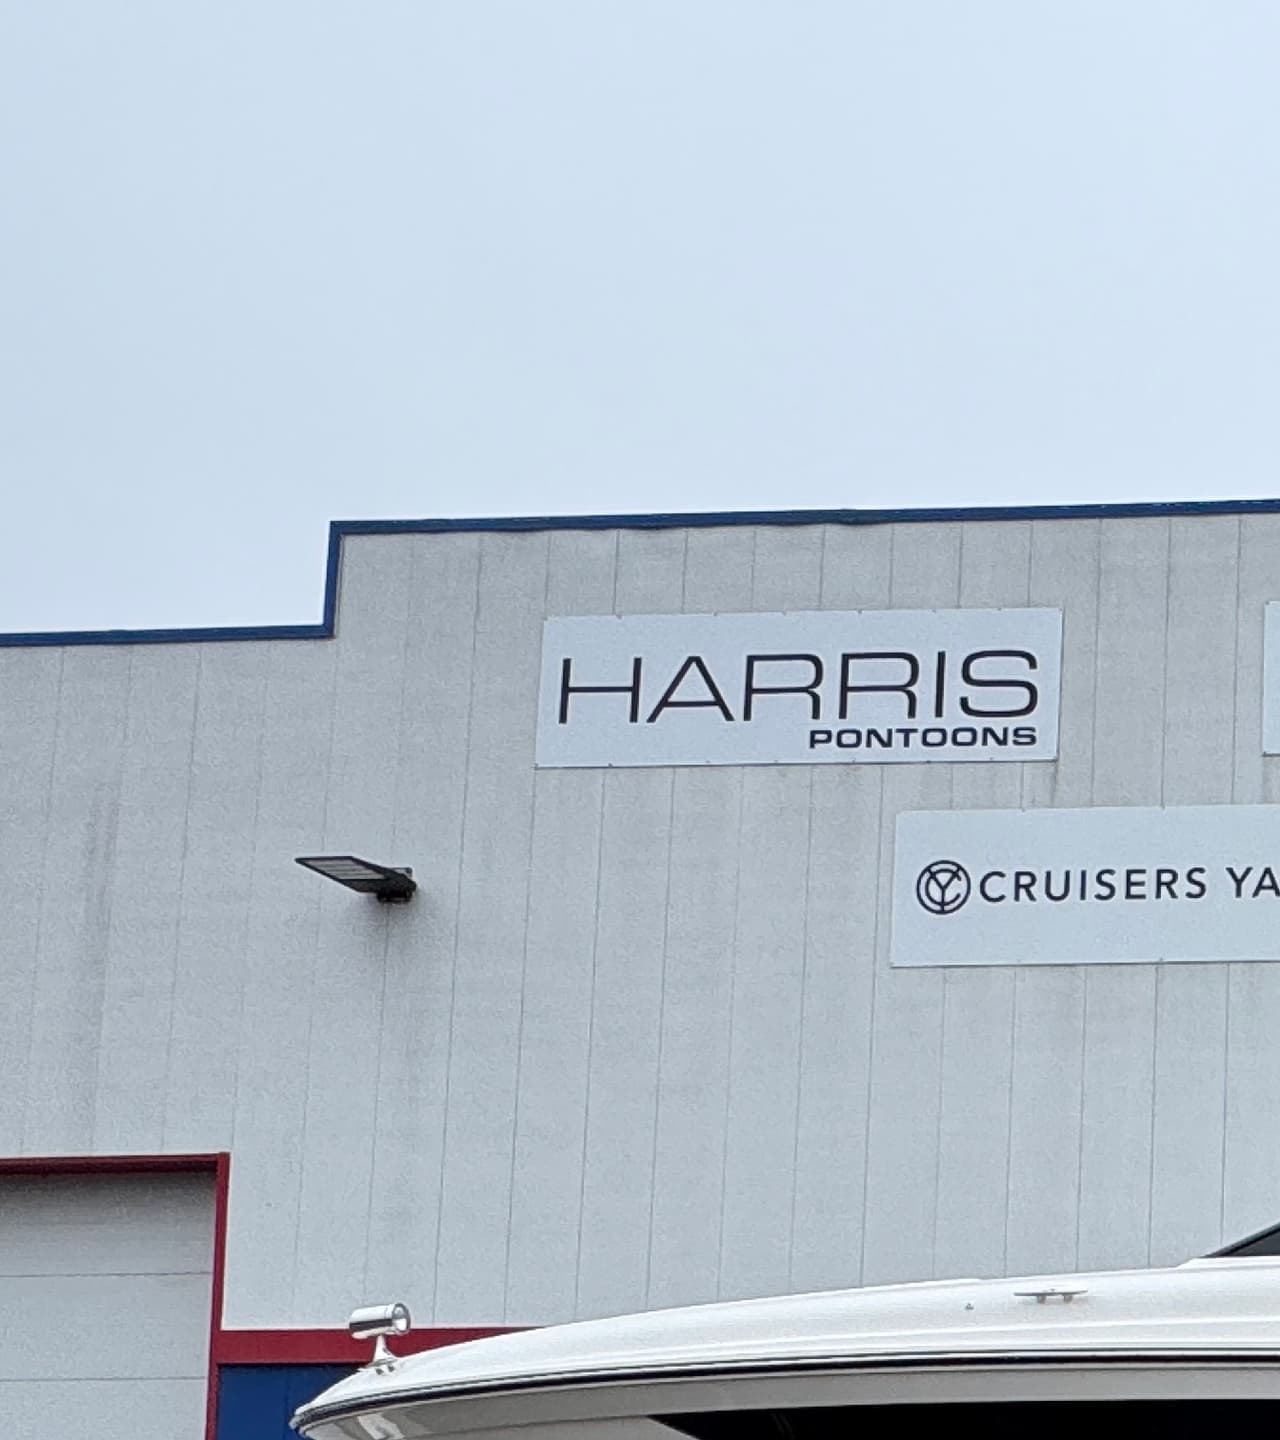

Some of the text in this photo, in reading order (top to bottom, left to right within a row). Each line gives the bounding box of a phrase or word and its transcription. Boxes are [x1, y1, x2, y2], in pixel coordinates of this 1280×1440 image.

[557, 649, 1039, 725] HARRIS
[808, 726, 1038, 749] PONTOONS
[979, 867, 1207, 903] CRUISERS
